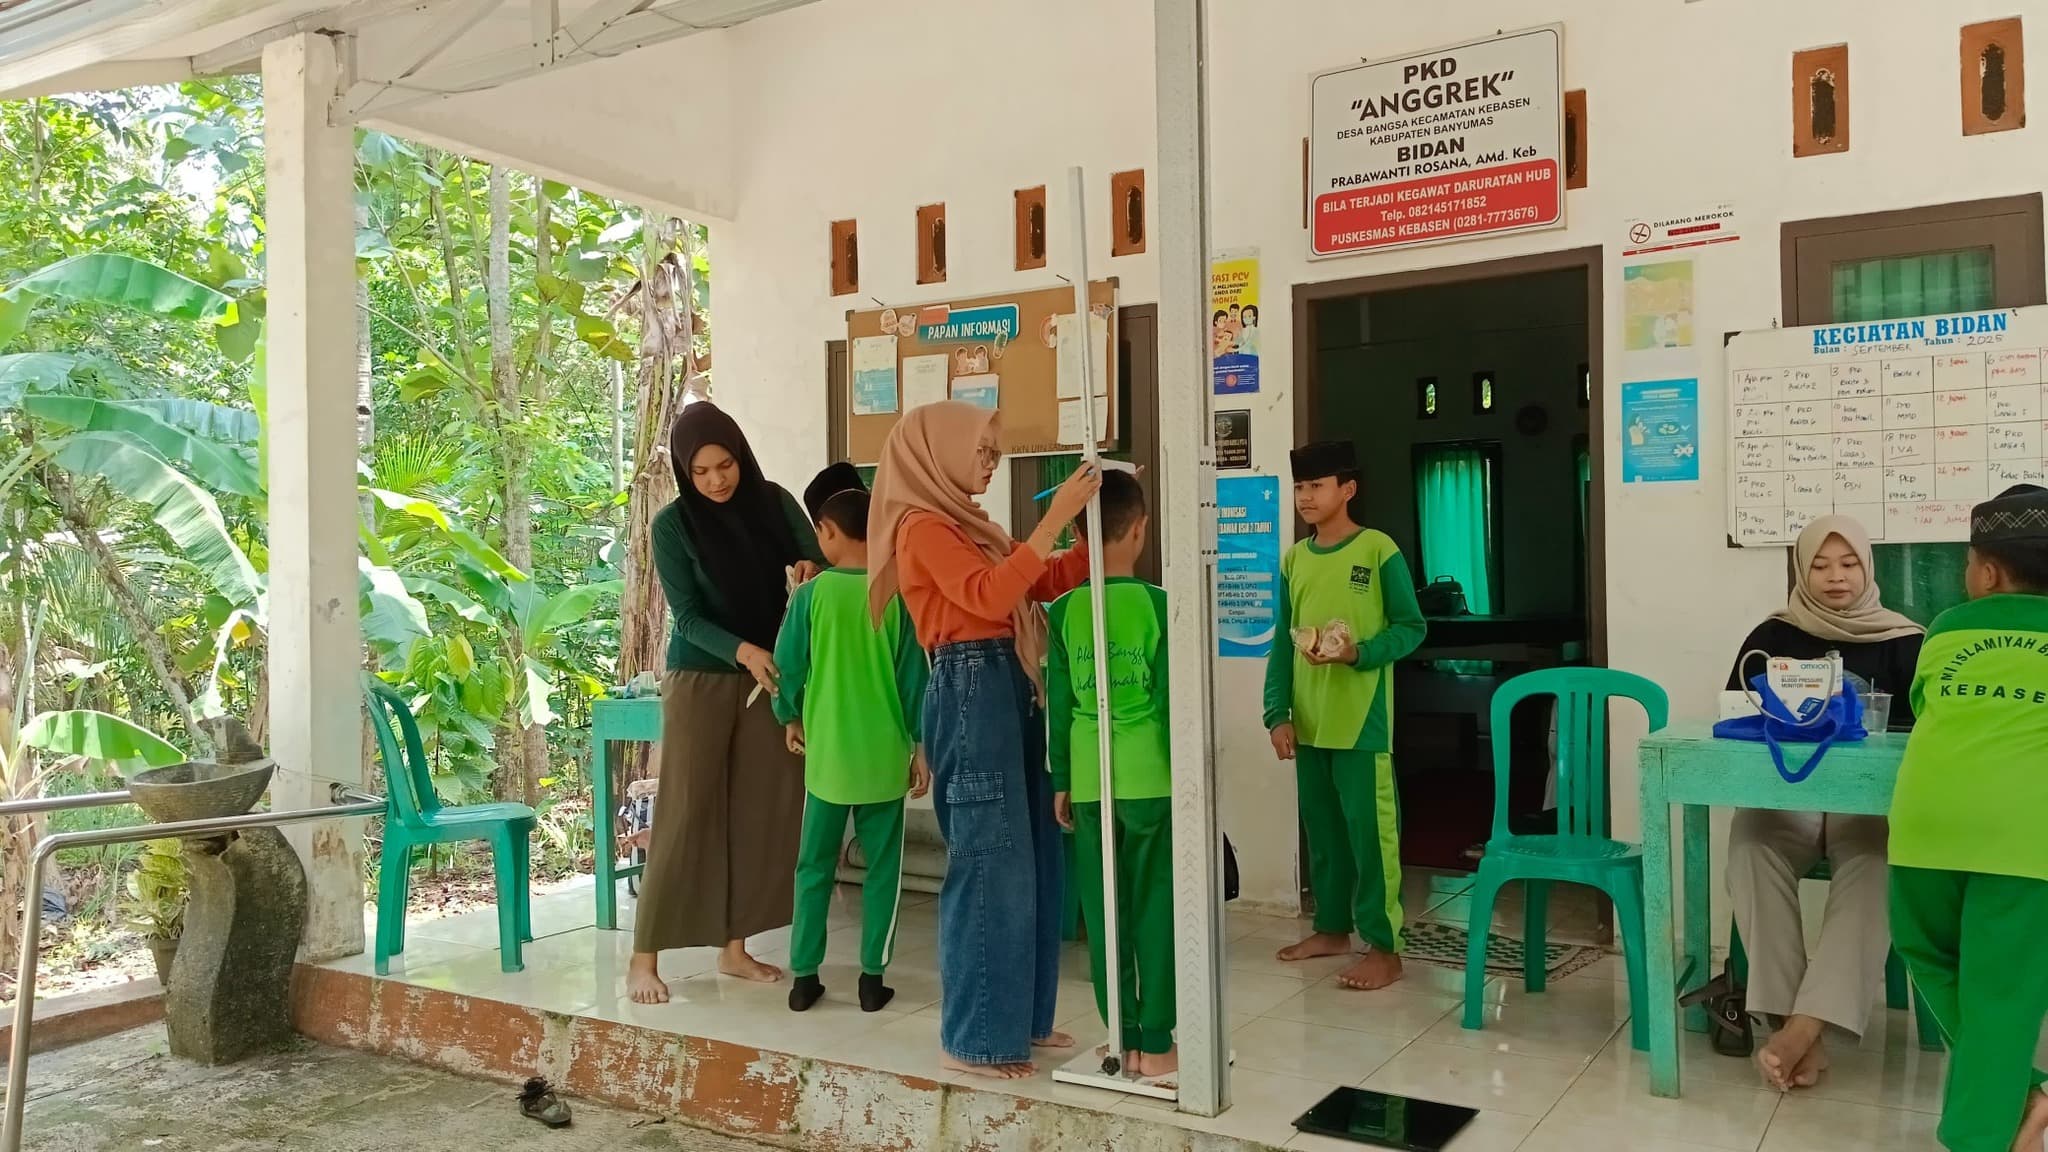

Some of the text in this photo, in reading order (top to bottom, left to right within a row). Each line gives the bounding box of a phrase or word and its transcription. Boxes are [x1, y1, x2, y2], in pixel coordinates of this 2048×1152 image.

[1403, 57, 1457, 84] PKD
[1337, 97, 1531, 140] DESA BANGSA KECAMATAN KEBASEN
[1370, 117, 1494, 146] KABUPATEN BANYUMAS
[1397, 137, 1465, 163] BIDAN
[1331, 146, 1537, 188] PRABAWANTI ROSANA, AMd. Keb
[1323, 168, 1551, 214] BILA TERJADI KEGAWAT DARURATAN HUB
[1381, 196, 1487, 222] Telp. 082145171852
[1654, 211, 1734, 228] DILARANG MEROKOK
[1331, 205, 1539, 246] PUSKESMAS KEBASEN (0281-7773676)
[1232, 272, 1250, 281] PCV
[928, 319, 1011, 339] PAPAN INFORMASI
[1813, 313, 2007, 346] KEGIATAN BIDAN
[1814, 346, 1840, 354] Bulan
[1924, 338, 1954, 346] Tahun
[1967, 334, 2004, 347] 2025
[1832, 368, 1839, 376] 3
[1990, 463, 2001, 472] 27
[1941, 666, 1957, 681] MI
[1952, 636, 2037, 666] ISLAMIYAH
